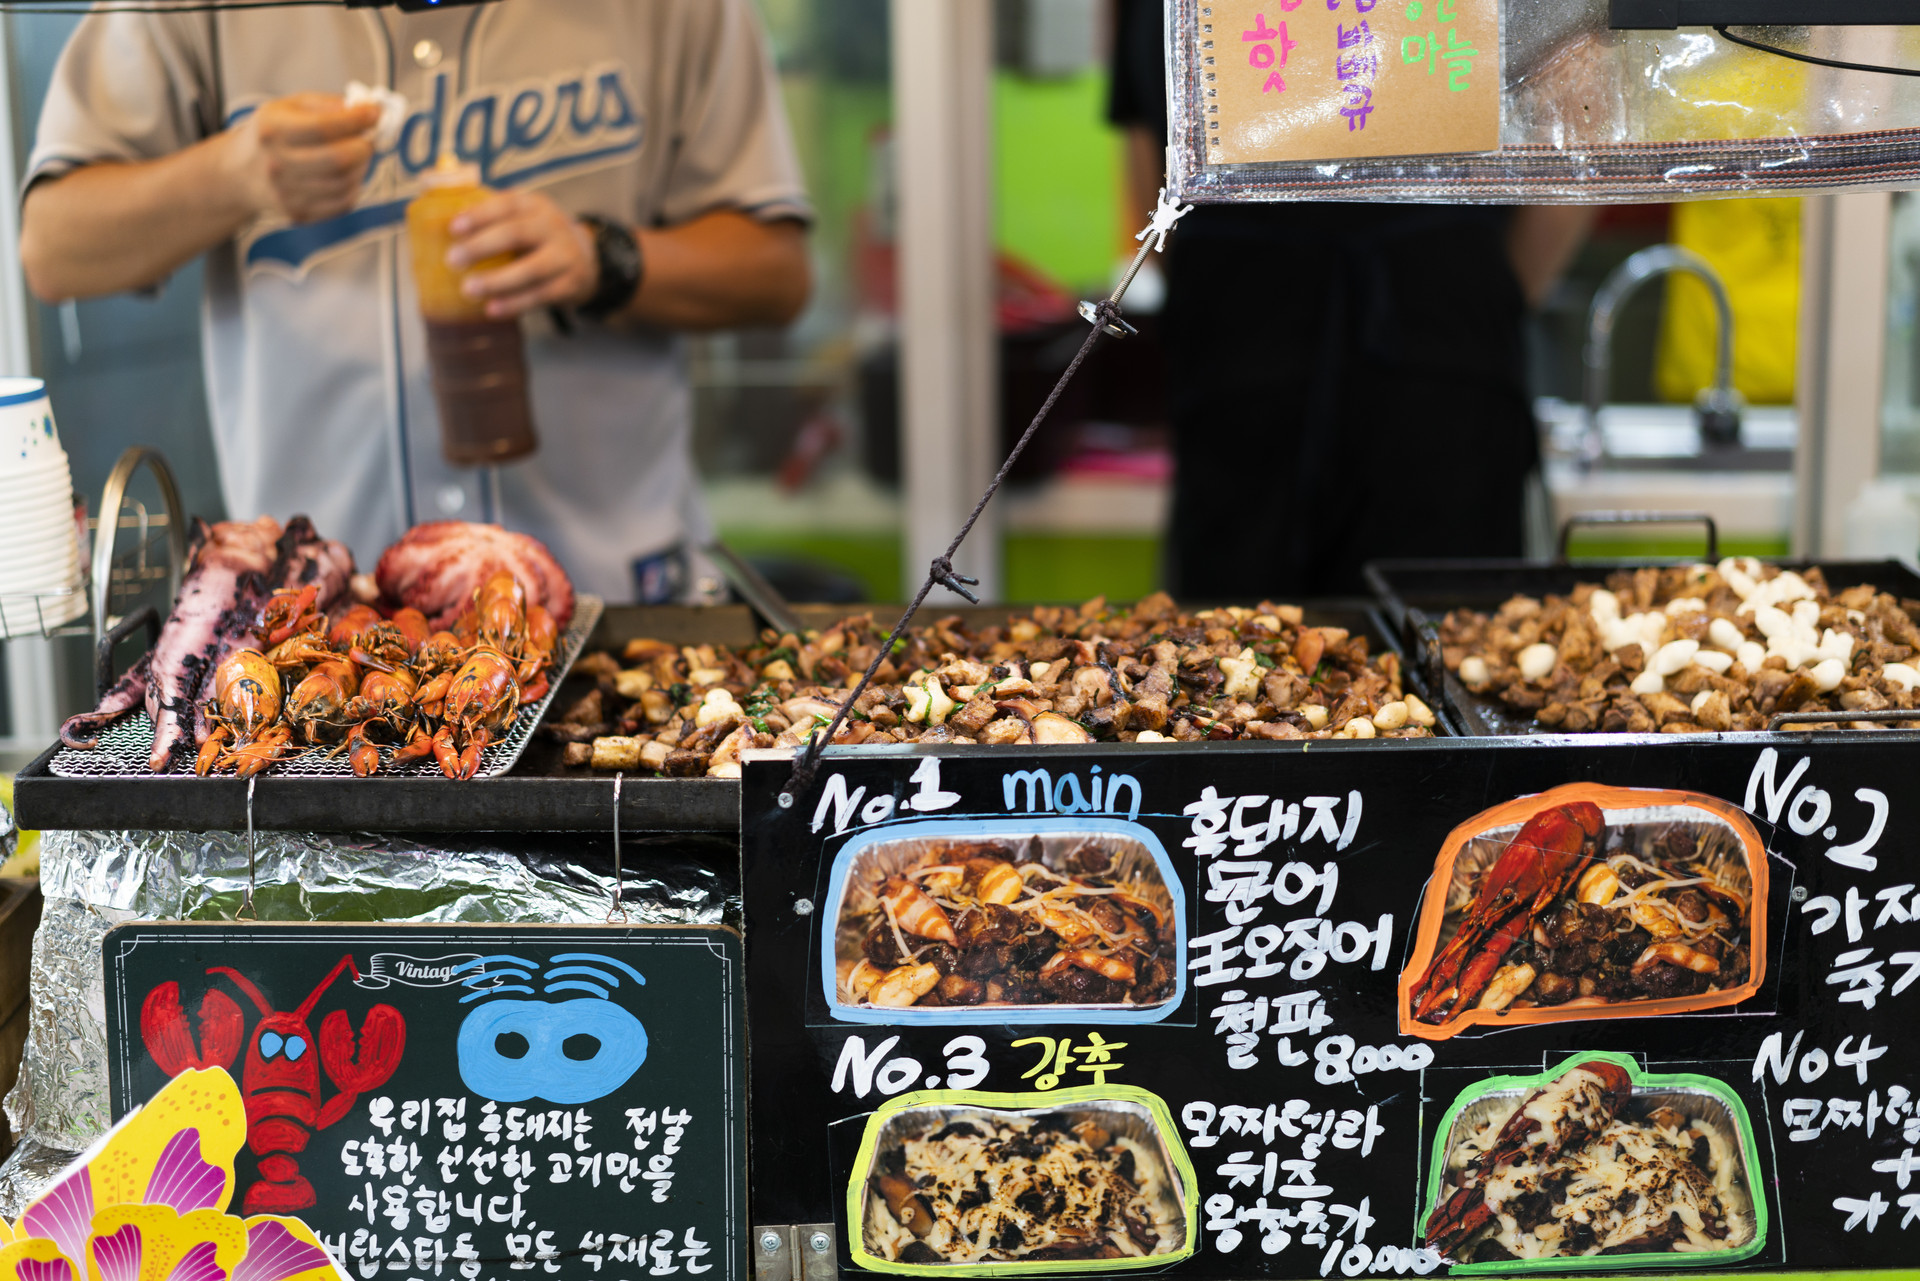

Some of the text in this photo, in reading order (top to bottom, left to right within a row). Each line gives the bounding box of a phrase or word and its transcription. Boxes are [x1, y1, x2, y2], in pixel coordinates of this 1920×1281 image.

[1401, 28, 1479, 92] 마늘
[1002, 764, 1142, 822] main
[1204, 860, 1339, 925] 문어
[1210, 989, 1333, 1070] 철판
[1010, 1032, 1129, 1090] 강추
[369, 1096, 467, 1142] 우리집
[625, 1106, 692, 1155] 전날
[436, 1144, 537, 1193] 신선한
[547, 1152, 676, 1203] 고기만을
[1216, 1151, 1334, 1198] 치즈
[505, 1230, 562, 1274] 모든
[579, 1226, 714, 1276] 식재료는
